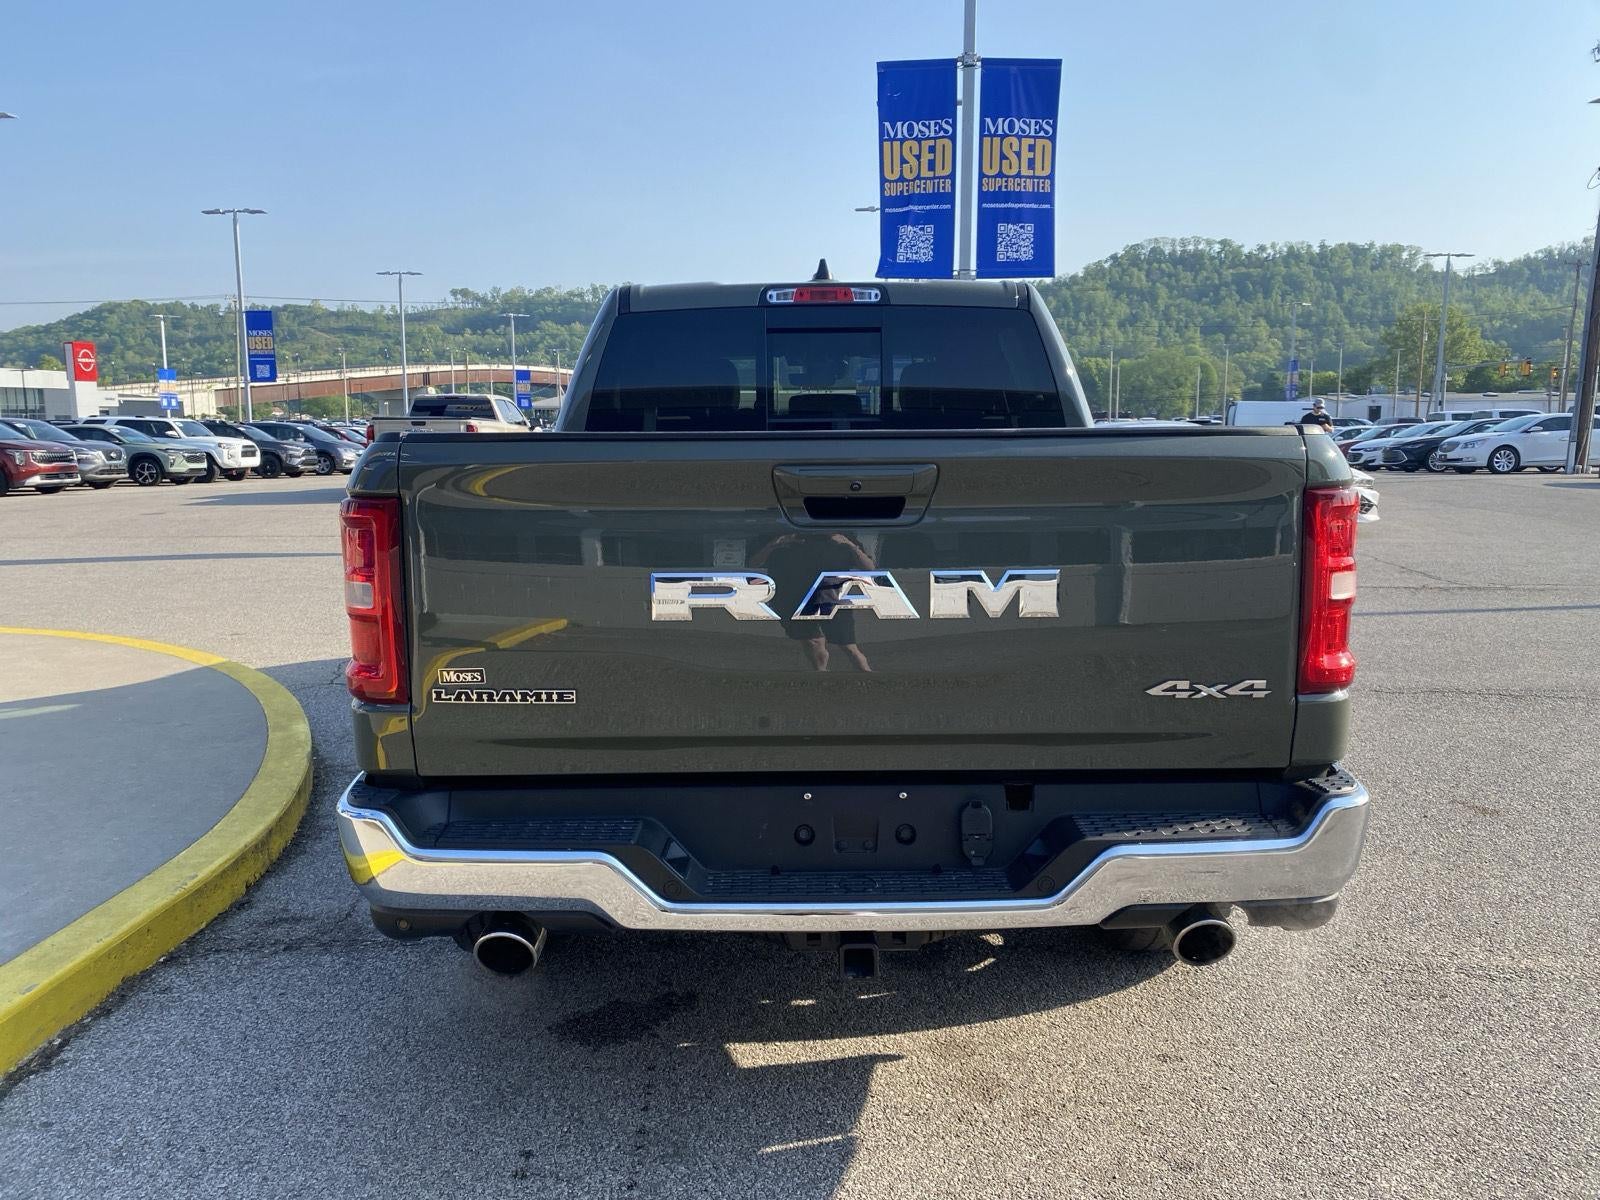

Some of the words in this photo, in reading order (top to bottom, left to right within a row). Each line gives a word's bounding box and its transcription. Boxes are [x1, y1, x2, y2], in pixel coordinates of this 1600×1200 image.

[883, 118, 953, 139] MOSES
[983, 117, 1053, 137] MOSES
[883, 138, 952, 180] USED
[982, 136, 1052, 176] USED
[884, 179, 952, 197] SUPERCENTER
[982, 177, 1051, 193] SUPERCENTER
[248, 329, 273, 337] MOSES
[248, 336, 274, 350] USED
[650, 568, 1061, 622] RAM
[442, 670, 482, 683] MOSES
[432, 688, 577, 705] LARAMIE
